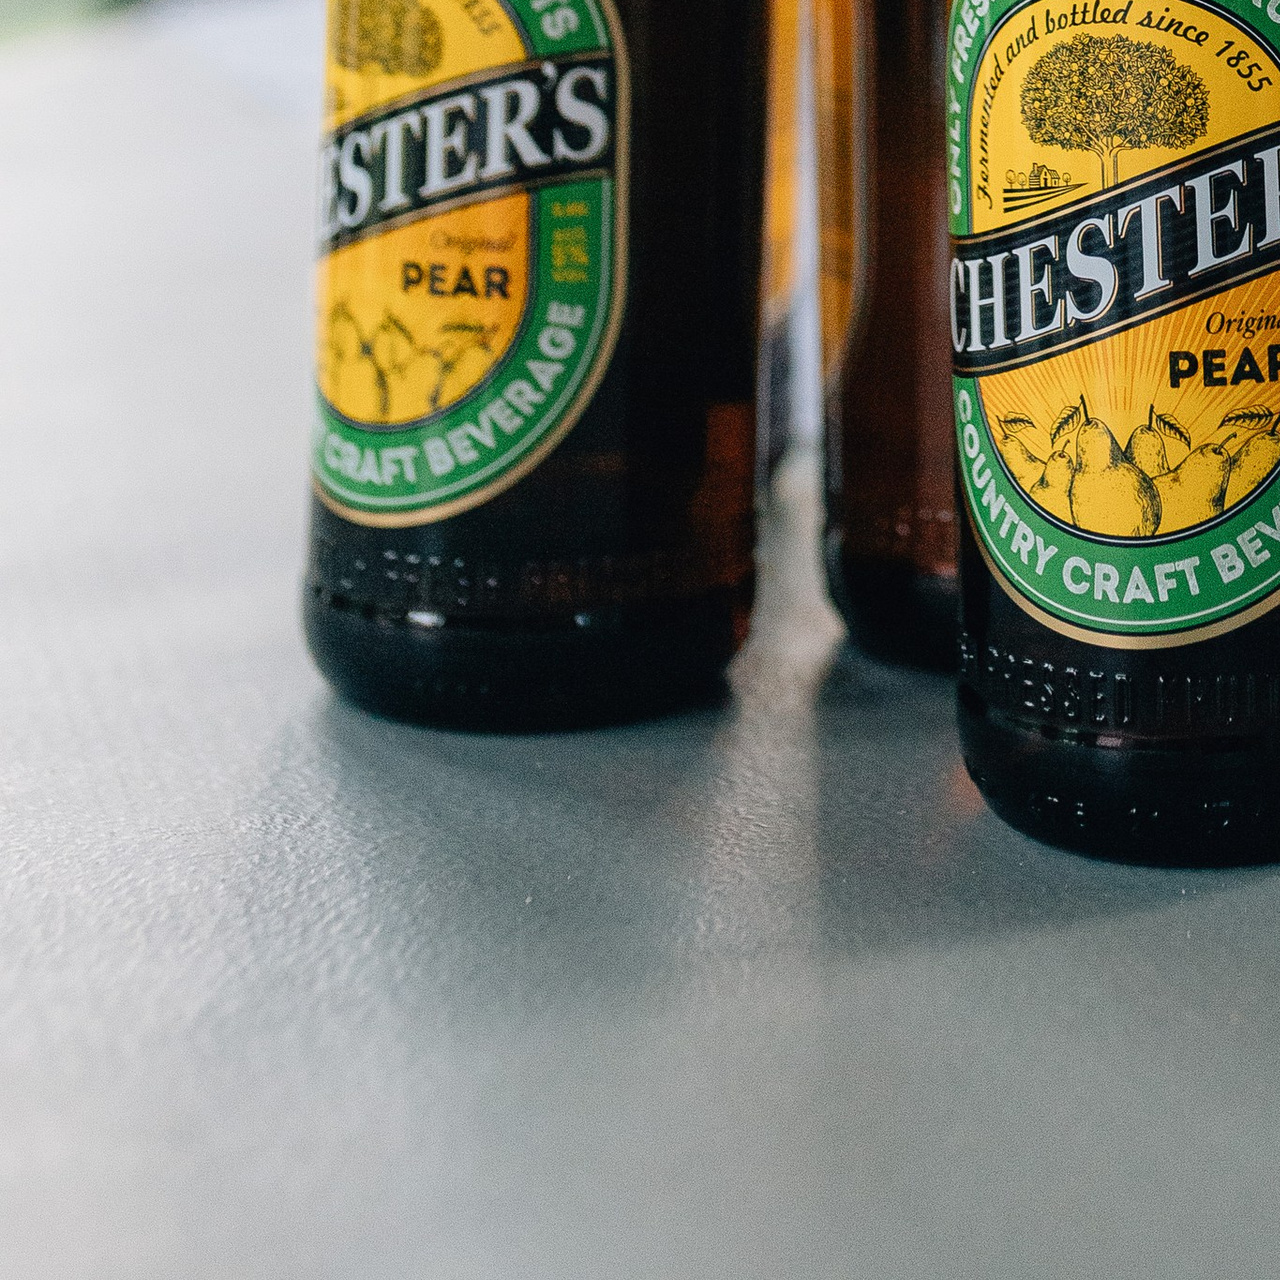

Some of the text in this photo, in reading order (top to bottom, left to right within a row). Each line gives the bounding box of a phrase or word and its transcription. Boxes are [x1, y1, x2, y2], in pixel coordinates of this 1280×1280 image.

[976, 0, 1274, 210] Fermented and bottled since 1855
[401, 261, 512, 300] PEAR
[324, 300, 587, 486] CRAFT BEVERAGE
[958, 391, 1059, 577] COUNTRY
[1062, 555, 1201, 604] CRAFT
